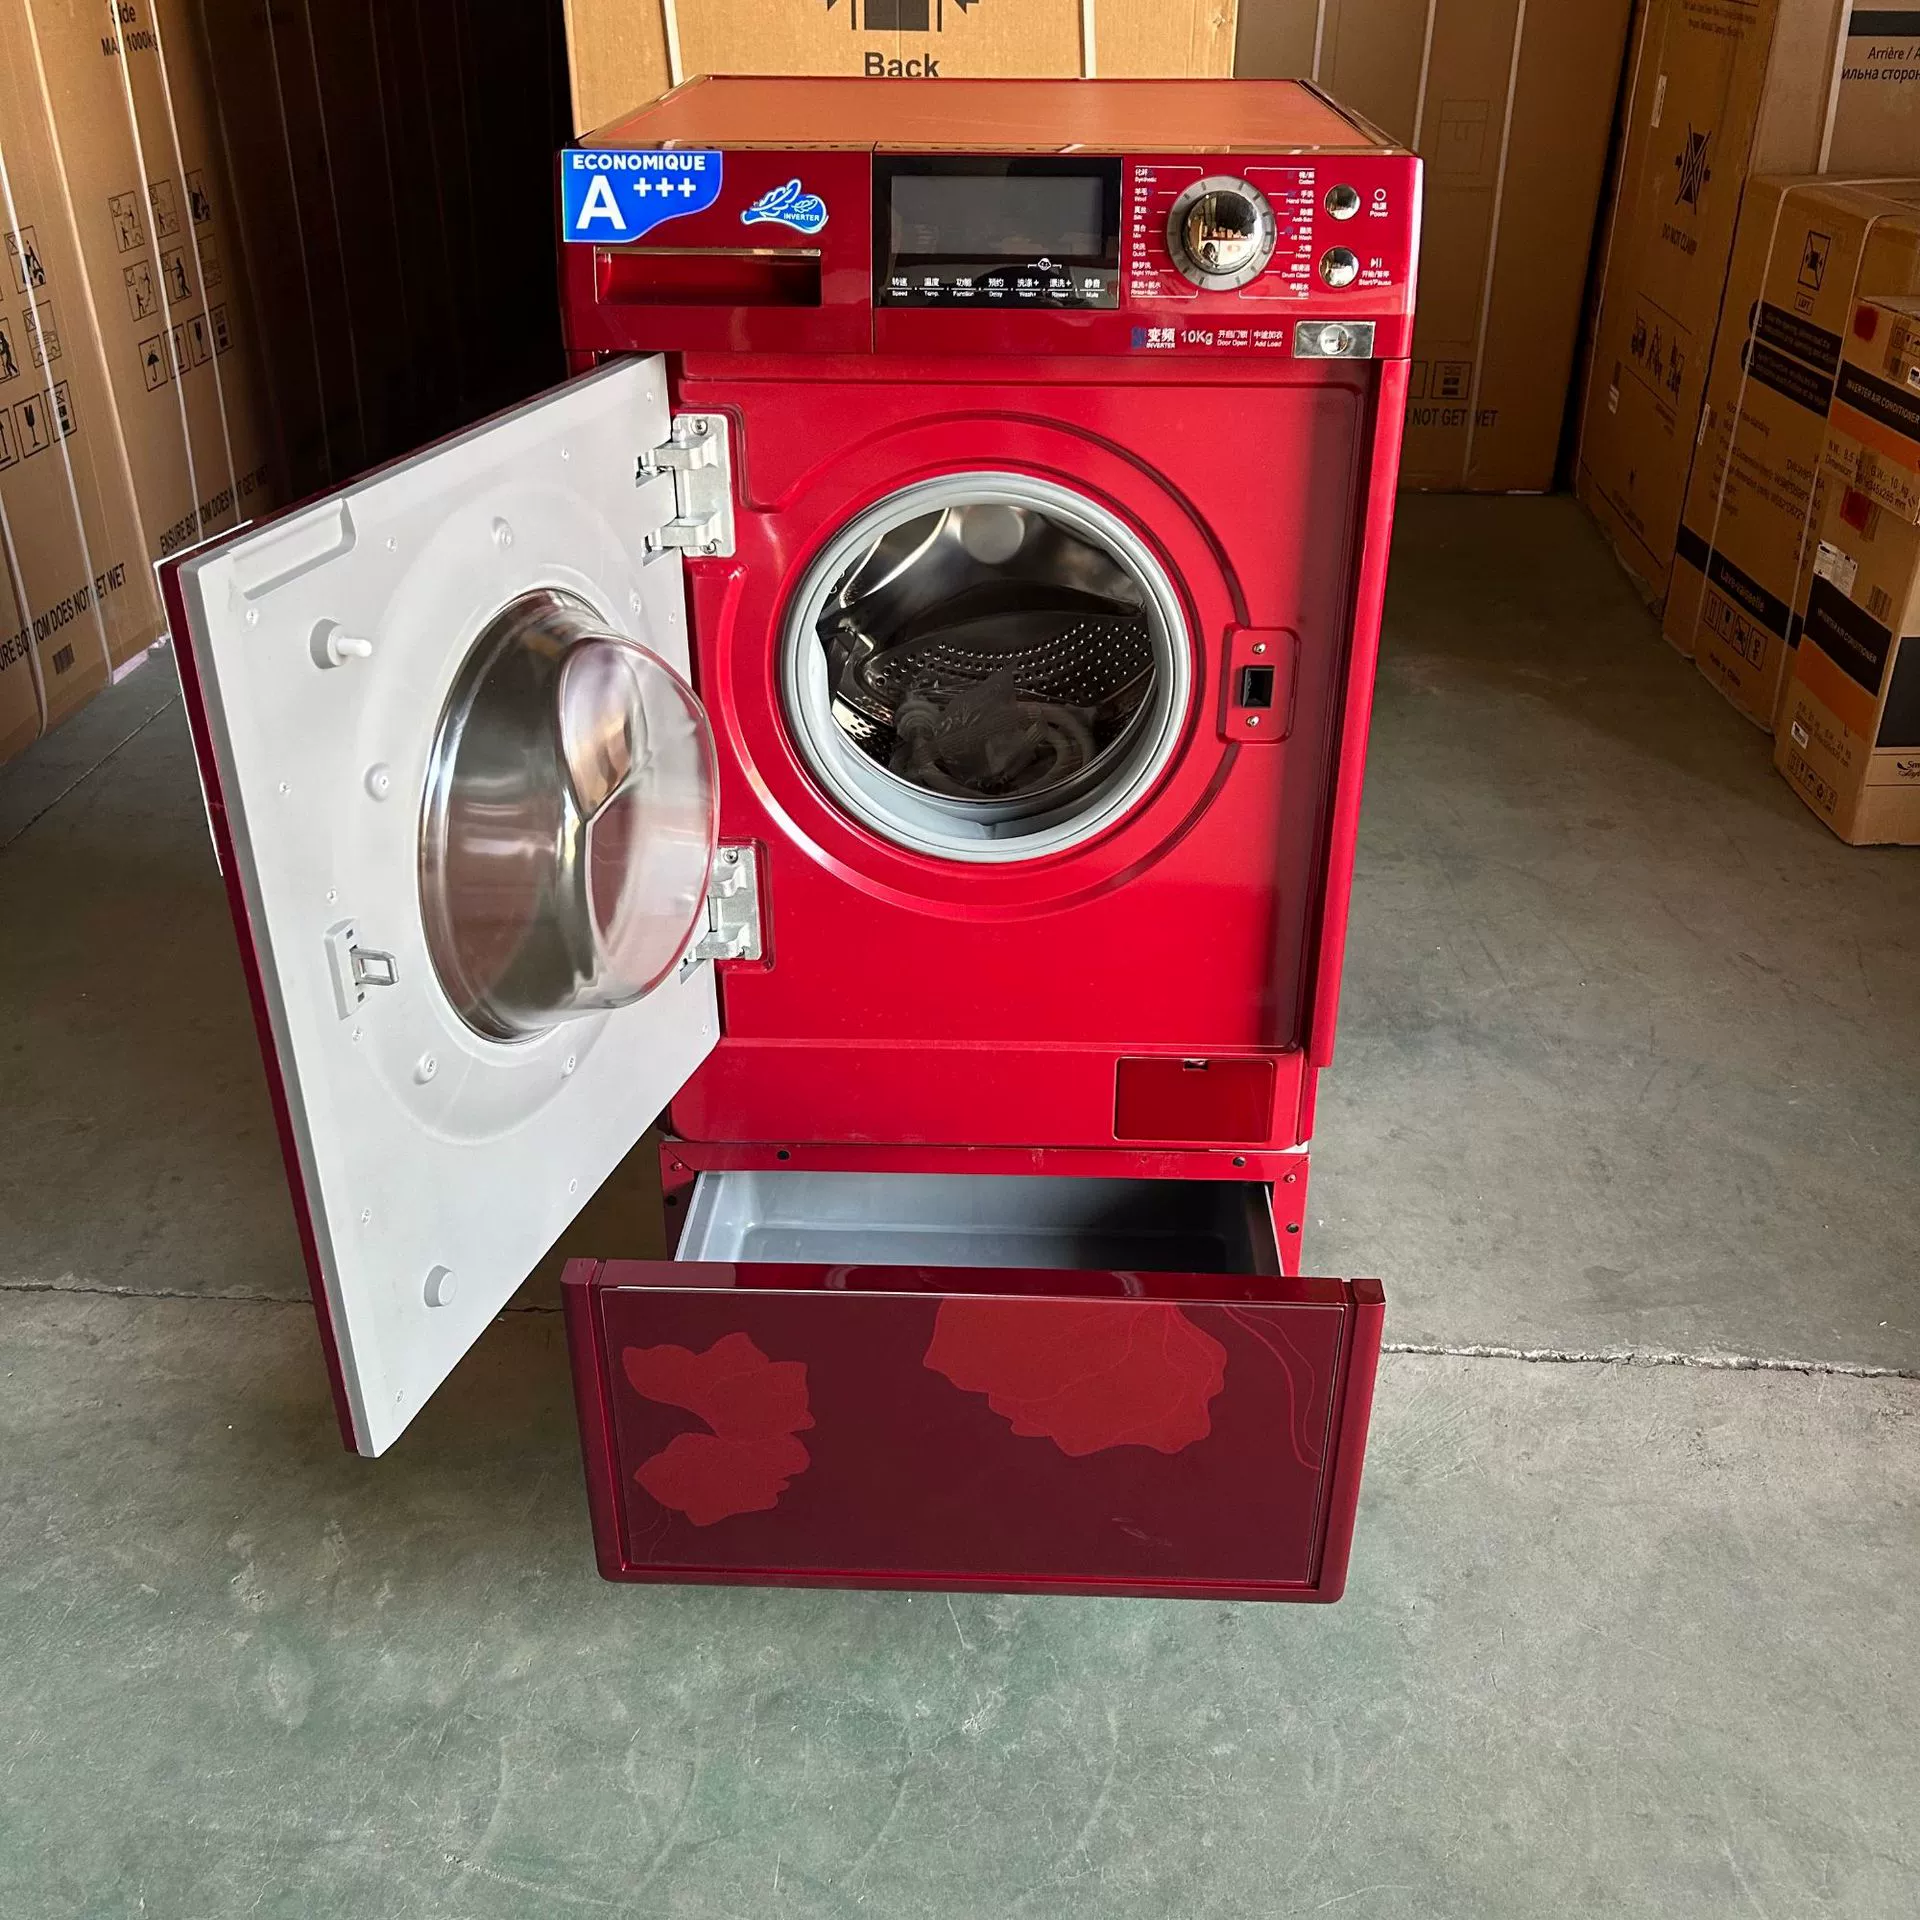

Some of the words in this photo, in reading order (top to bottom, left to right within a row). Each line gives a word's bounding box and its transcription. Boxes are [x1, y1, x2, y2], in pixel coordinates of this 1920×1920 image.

[1867, 46, 1905, 60] Arrière
[864, 52, 941, 78] Back
[572, 154, 706, 171] ECONOMIQUE
[575, 174, 628, 231] A
[783, 211, 821, 226] INVERTER
[1369, 210, 1389, 218] Power
[1147, 327, 1176, 343] 变频
[1180, 329, 1214, 345] 10Kg
[1217, 338, 1232, 346] Door
[1232, 339, 1248, 348] Open
[1412, 407, 1440, 427] NOT
[1441, 408, 1469, 427] GET
[49, 597, 75, 632] DOES
[73, 586, 92, 615] NOT
[107, 562, 127, 592] WET
